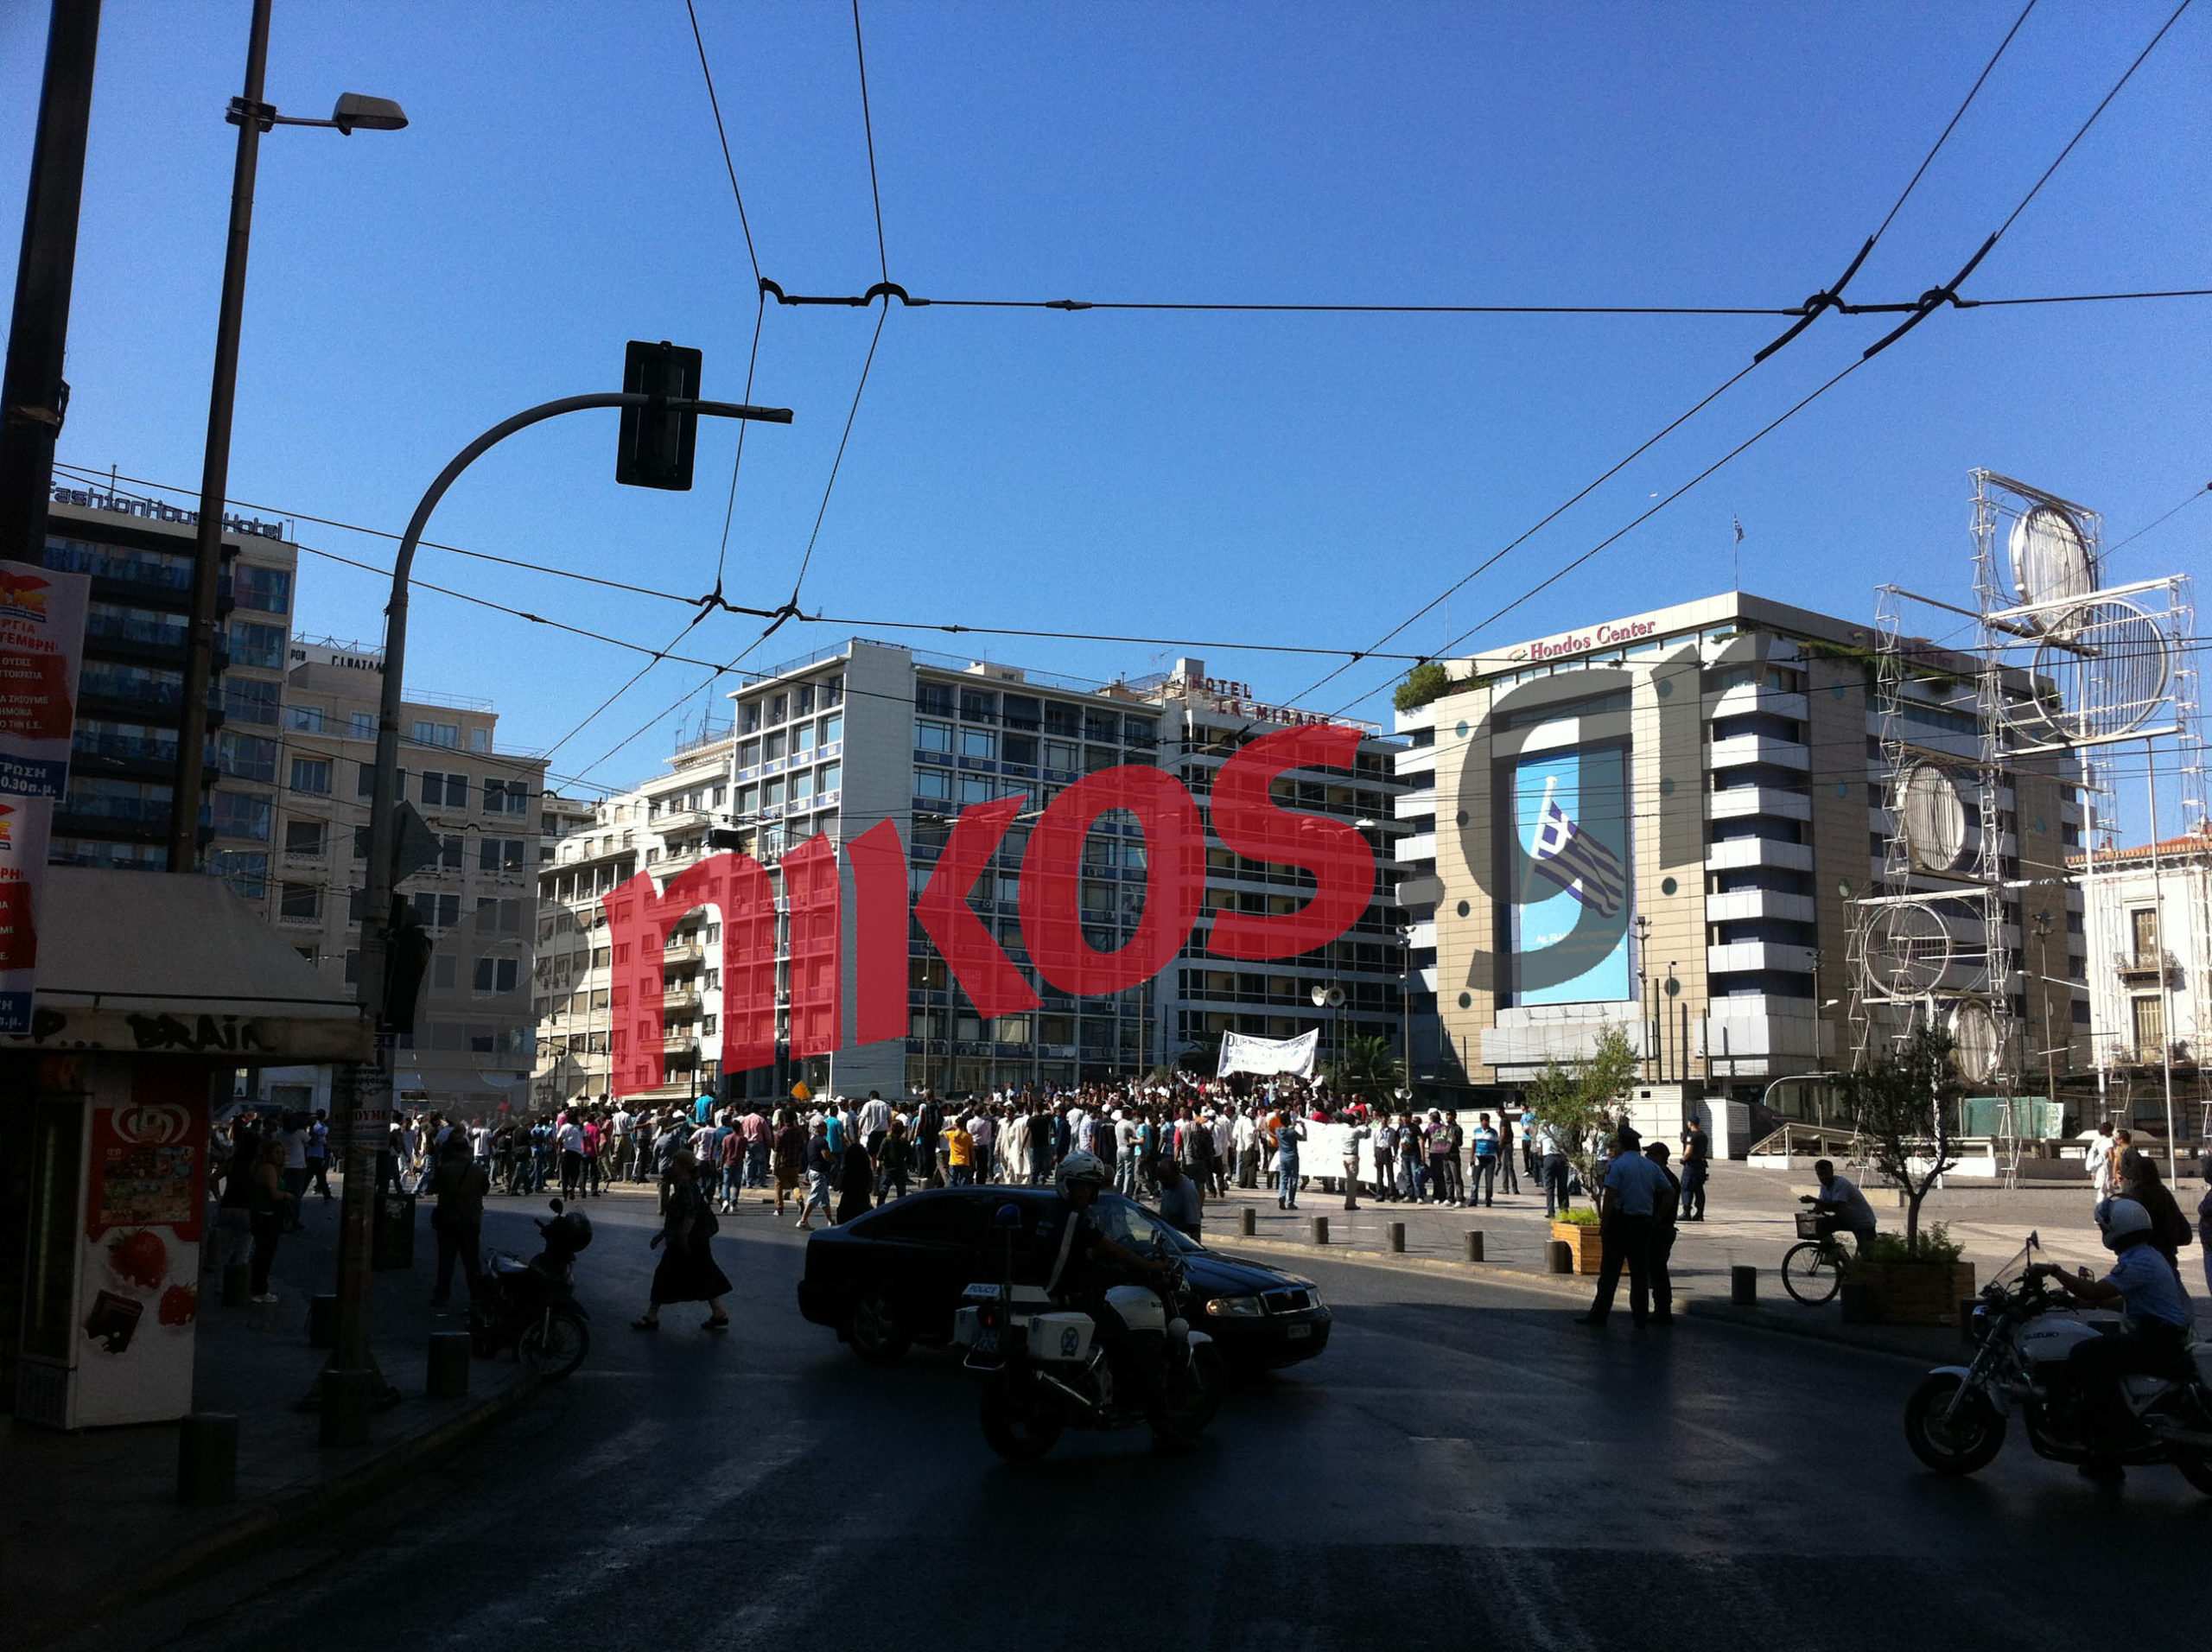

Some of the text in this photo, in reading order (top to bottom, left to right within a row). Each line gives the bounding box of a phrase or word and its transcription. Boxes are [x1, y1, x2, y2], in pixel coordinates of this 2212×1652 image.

[222, 511, 283, 541] Hotel
[1530, 619, 1656, 662] Hondos Center
[1190, 675, 1252, 699] HOTEL
[1217, 698, 1331, 727] LA MIRAGE
[2024, 1331, 2060, 1340] SUZUKI
